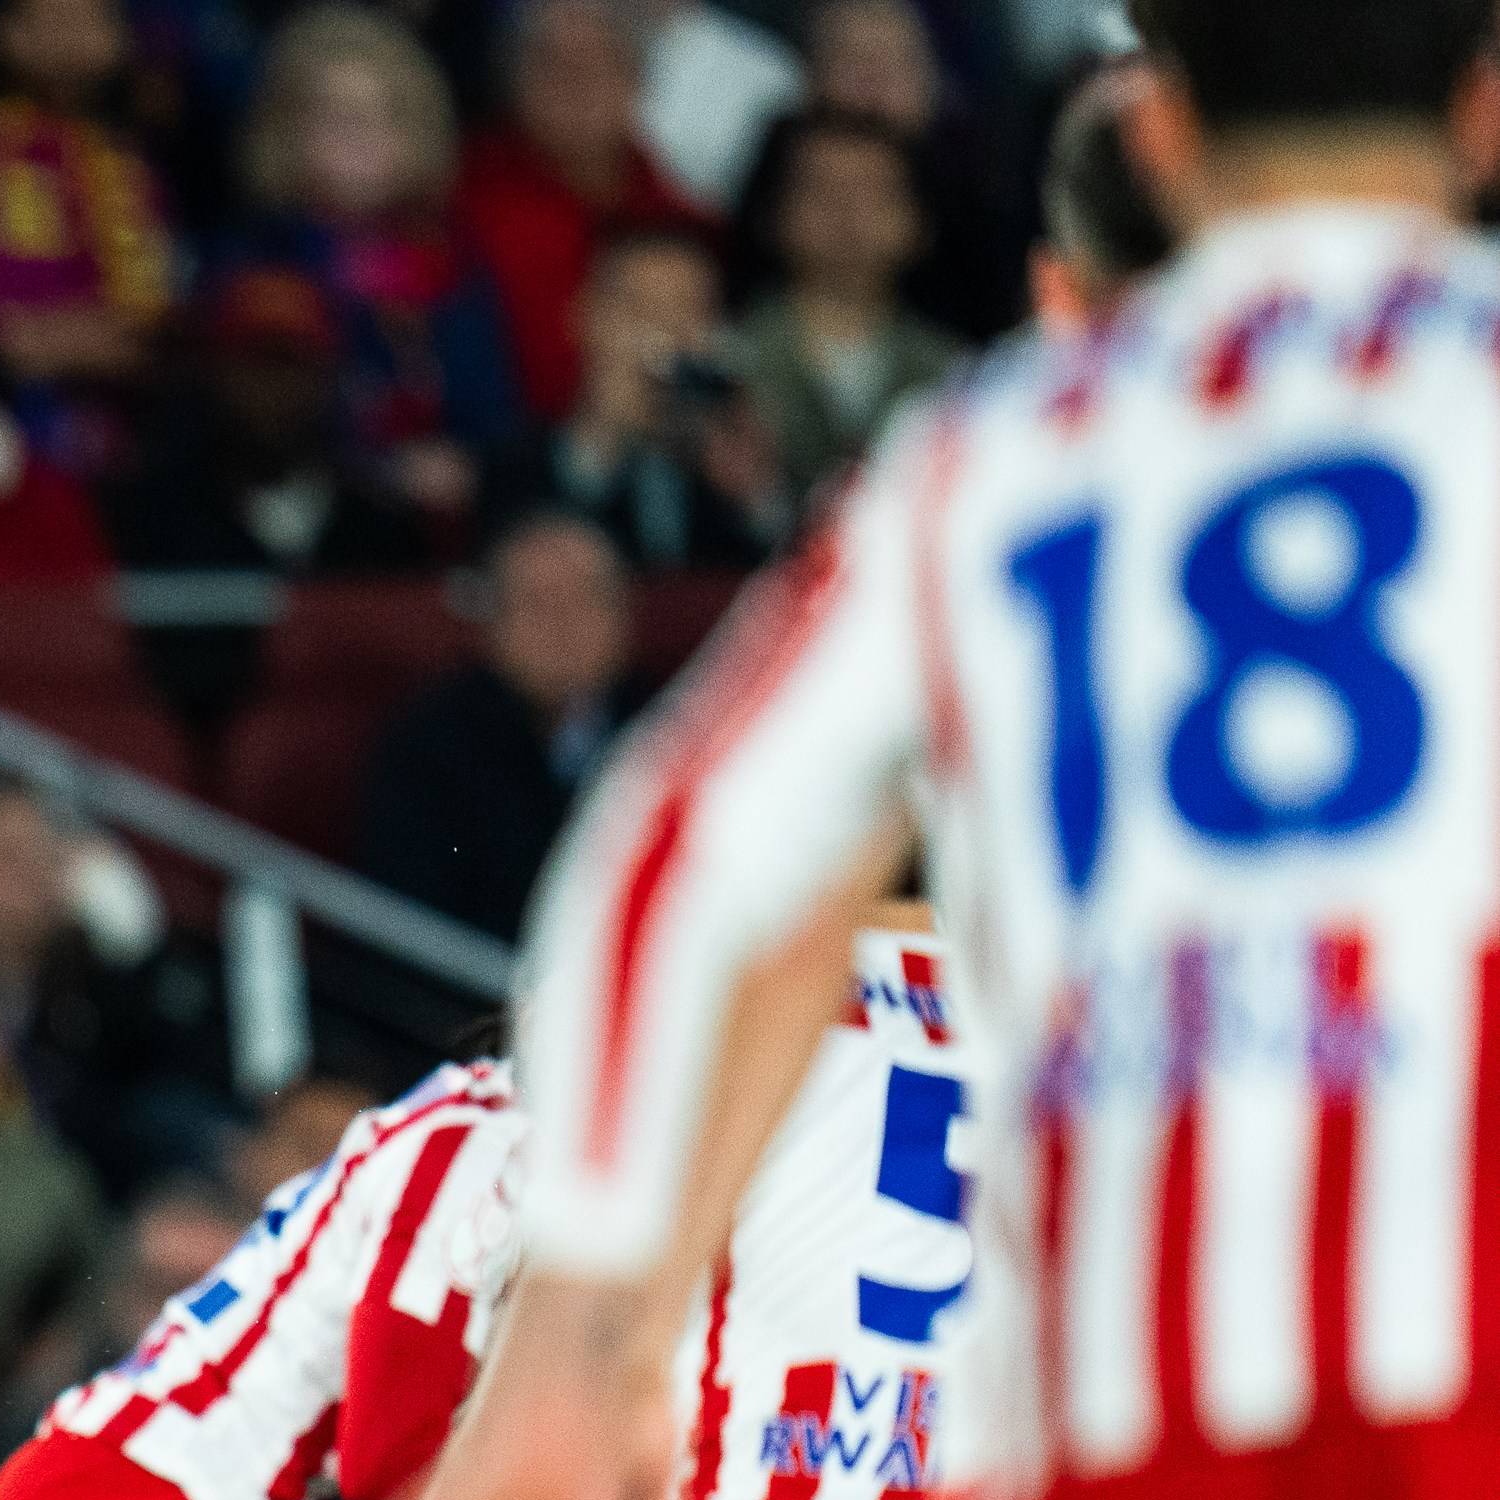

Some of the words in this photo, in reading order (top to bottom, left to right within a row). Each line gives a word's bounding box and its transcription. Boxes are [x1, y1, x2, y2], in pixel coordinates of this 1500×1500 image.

[1004, 448, 1428, 900] 18
[858, 1063, 968, 1345] 5
[758, 1420, 932, 1490] RWA
